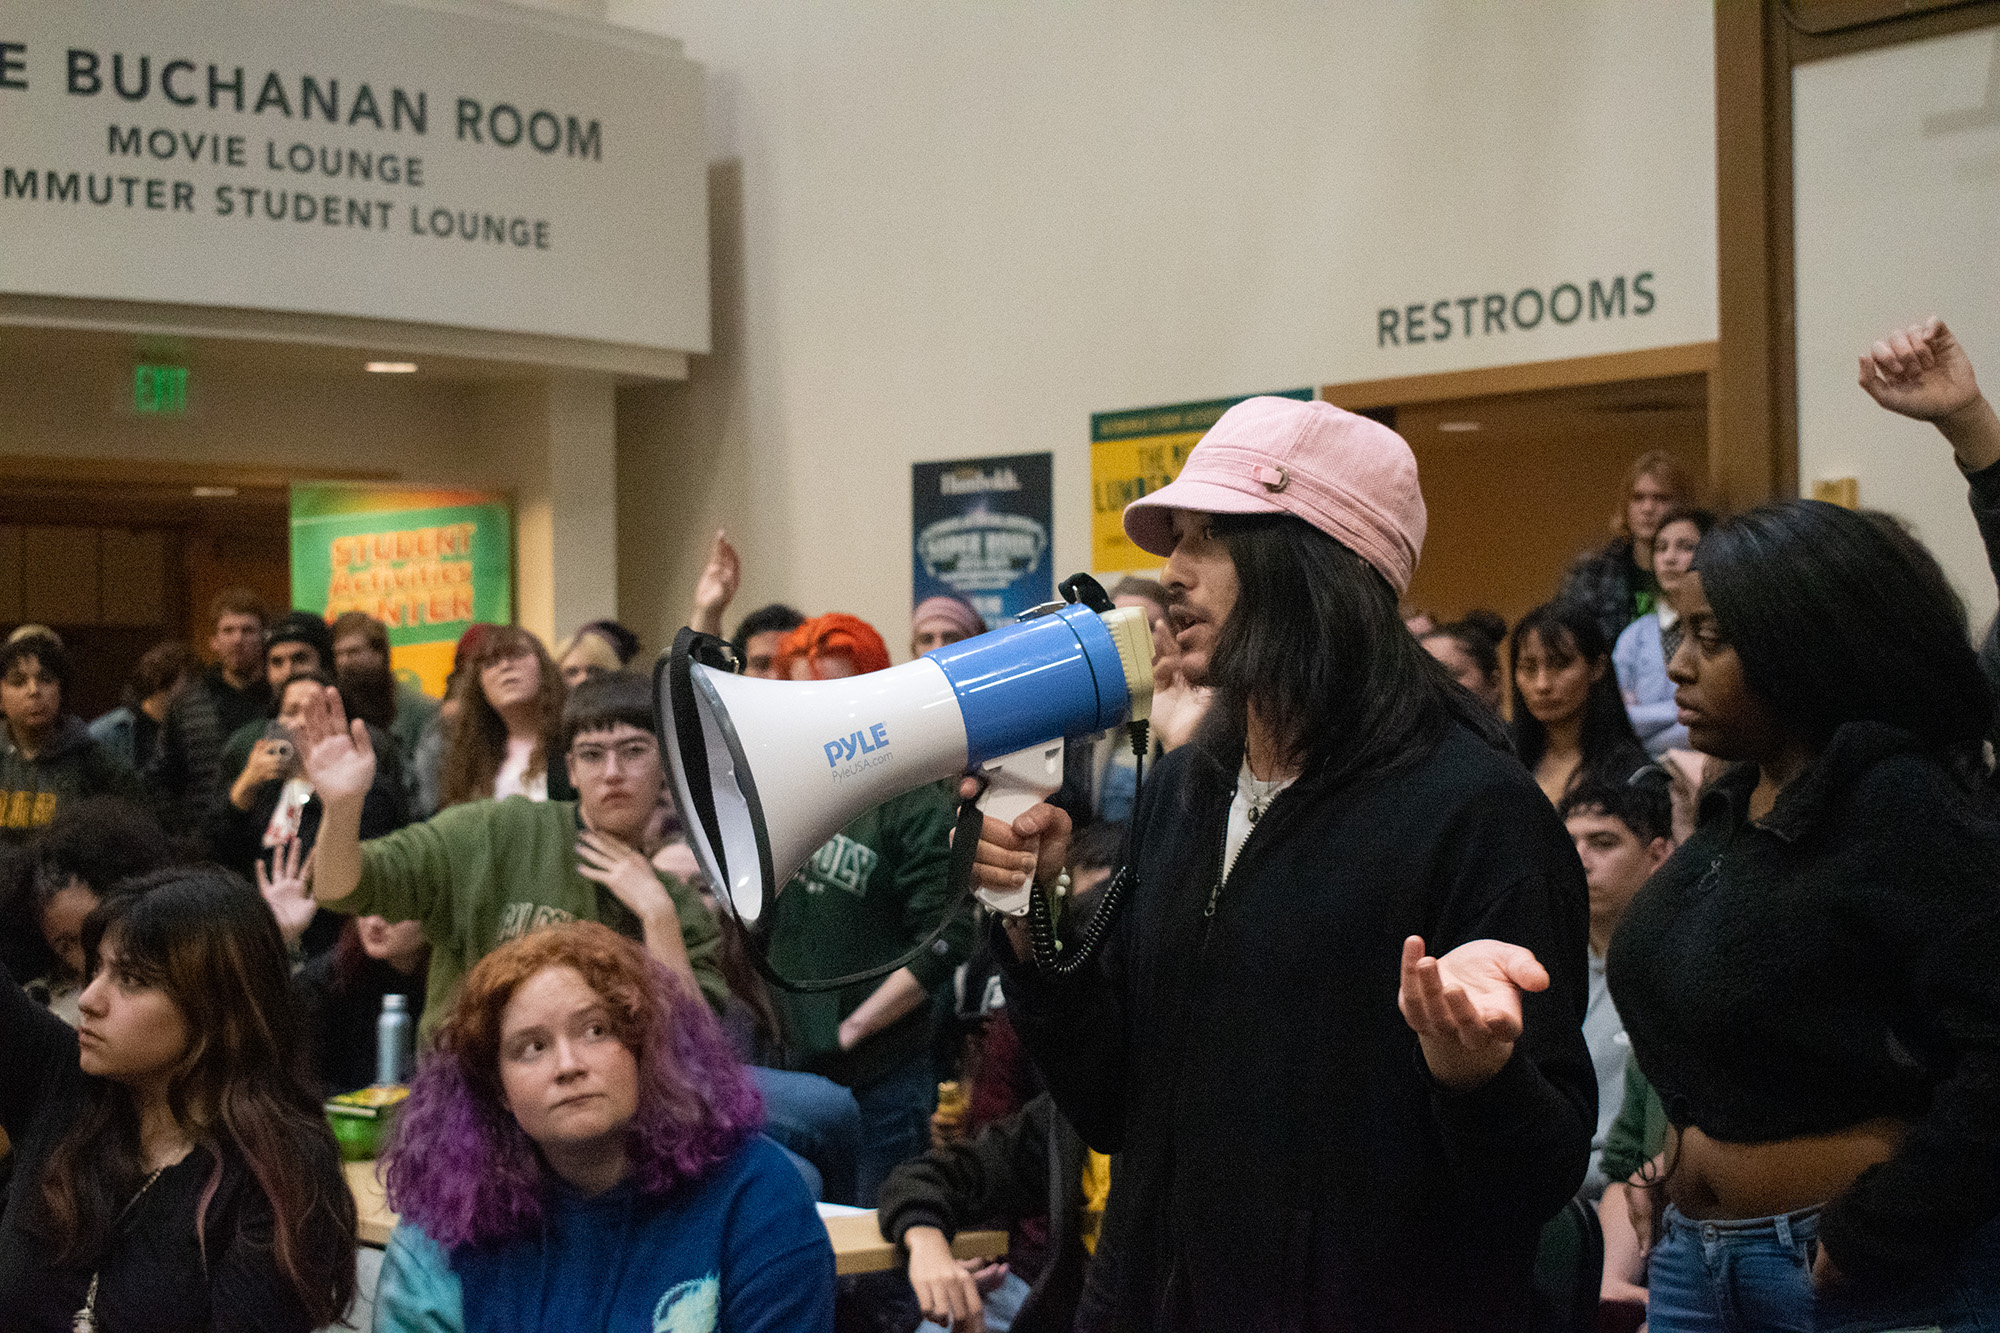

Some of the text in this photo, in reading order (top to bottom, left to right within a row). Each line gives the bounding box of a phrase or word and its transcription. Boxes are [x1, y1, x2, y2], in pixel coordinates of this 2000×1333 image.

[67, 49, 428, 135] BUCHANAN
[456, 96, 602, 161] ROOM
[109, 124, 423, 187] MOVIE LOUNGE
[216, 185, 392, 230] STUDENT
[410, 204, 550, 250] LOUNGE
[1377, 271, 1655, 348] RESTROOMS
[136, 365, 187, 411] EXIT
[331, 521, 476, 568] STUDENT
[823, 722, 889, 768] PYLE
[831, 751, 894, 783] PyleUSA.com
